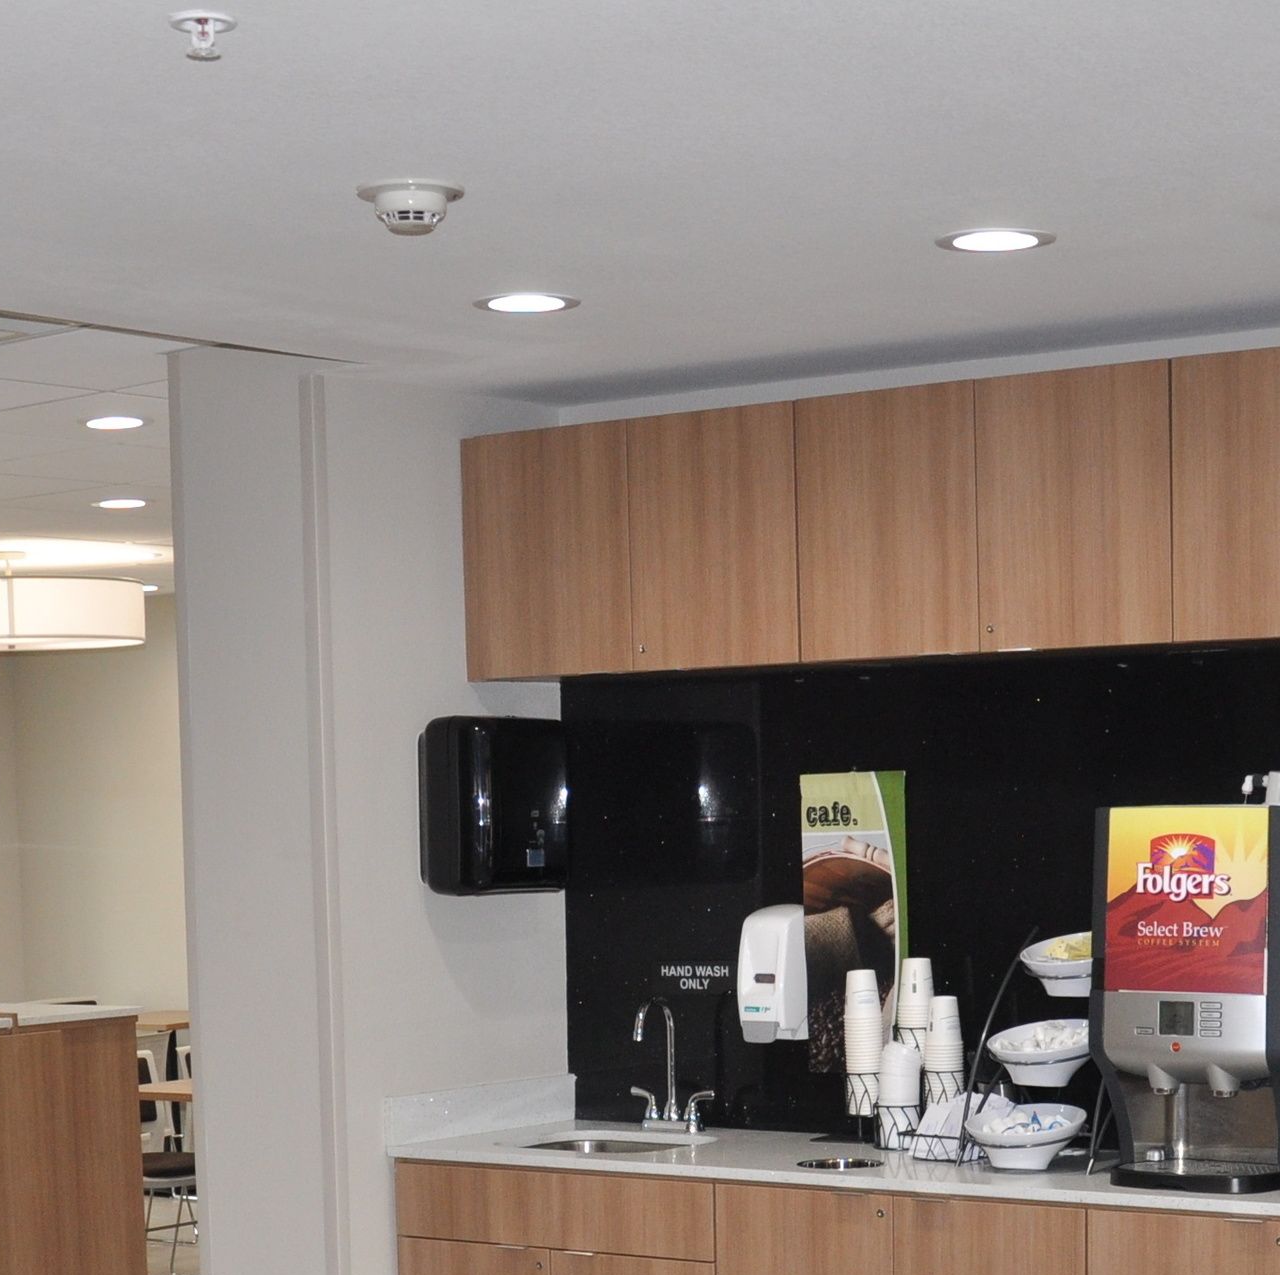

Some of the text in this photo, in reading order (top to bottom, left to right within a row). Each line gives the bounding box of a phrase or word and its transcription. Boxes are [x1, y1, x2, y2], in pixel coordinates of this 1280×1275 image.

[806, 801, 858, 828] cafe.
[1136, 862, 1232, 903] Folgers
[1137, 921, 1224, 938] Select Brew
[1179, 939, 1220, 947] SYSTEM
[661, 965, 729, 977] HAND WASH
[679, 978, 710, 990] ONLY
